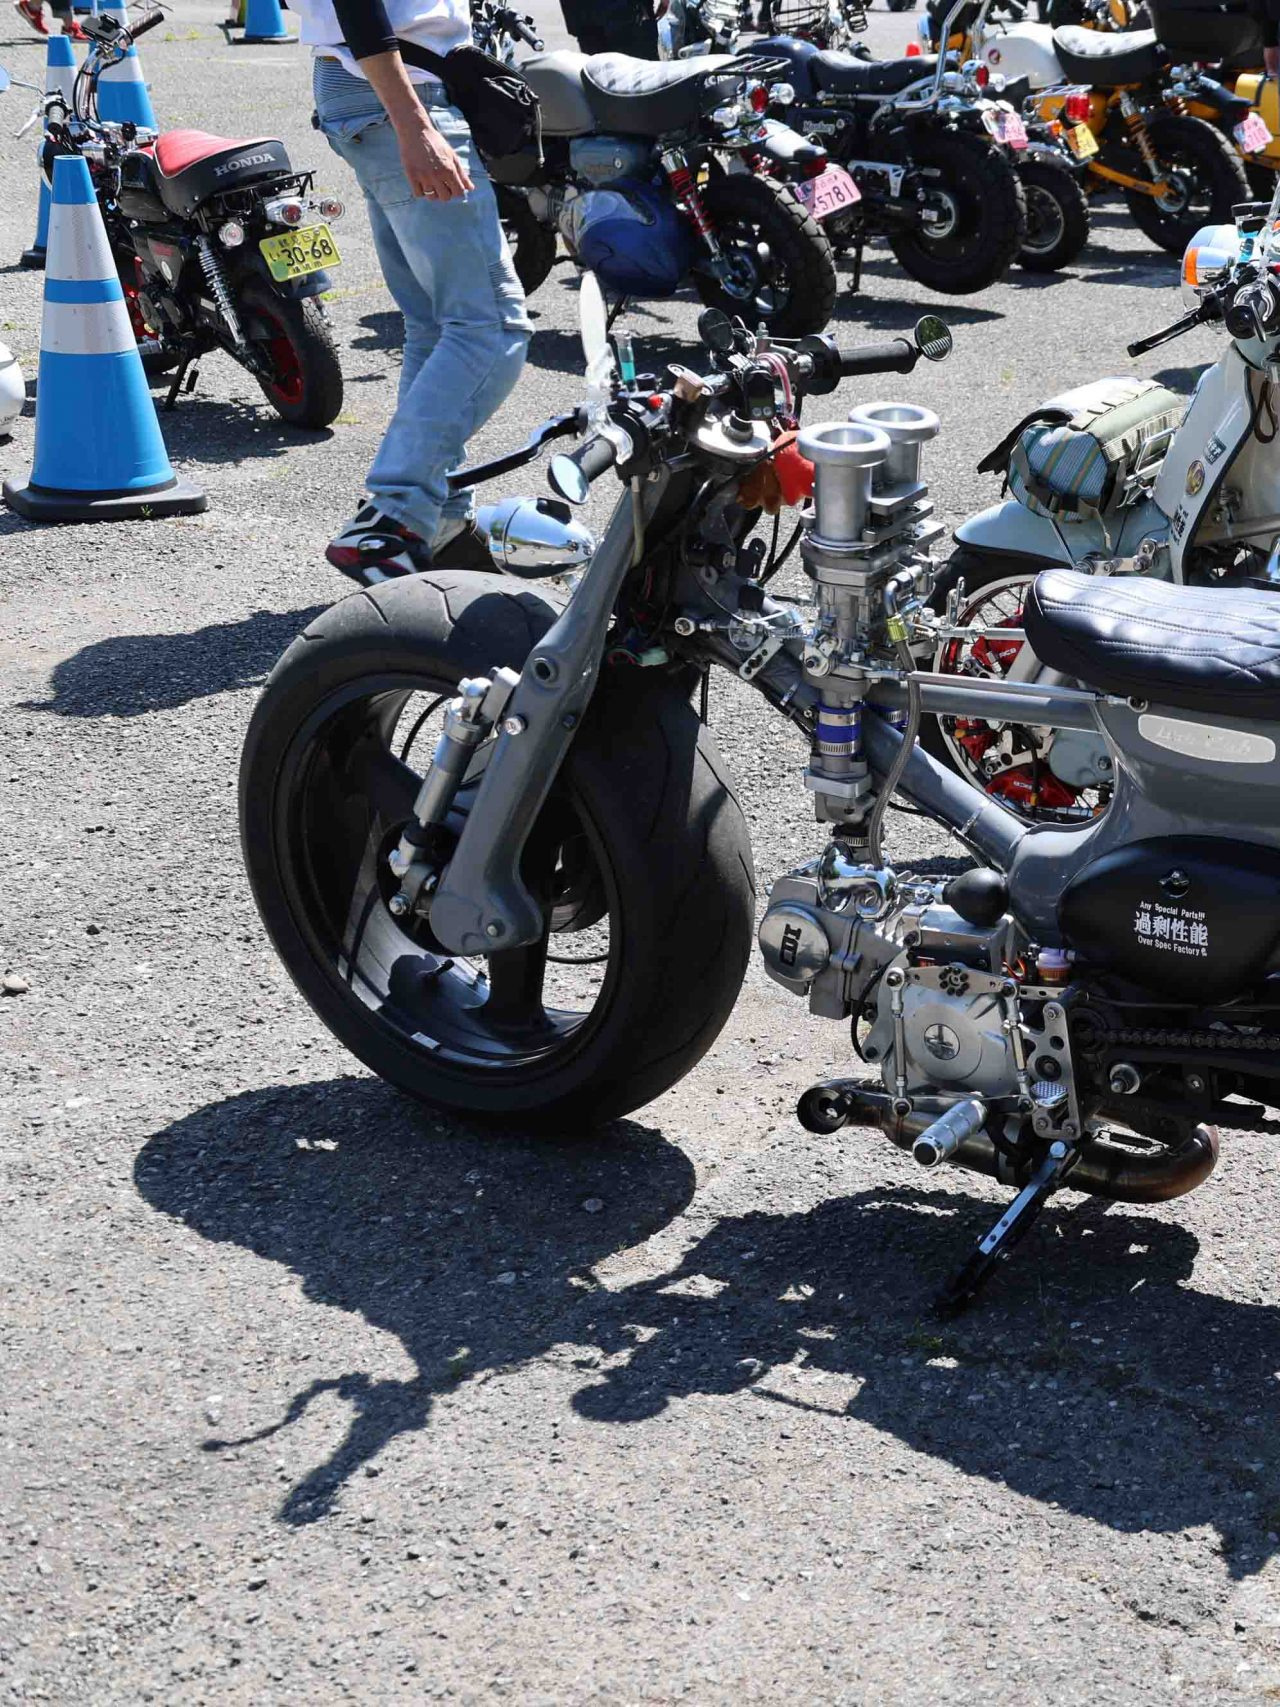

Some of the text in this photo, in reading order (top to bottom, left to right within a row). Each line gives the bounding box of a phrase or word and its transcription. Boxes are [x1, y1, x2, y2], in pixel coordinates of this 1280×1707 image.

[214, 153, 276, 177] HONDA
[817, 181, 854, 211] 5781
[281, 239, 333, 266] 30-68
[1139, 900, 1152, 911] Any
[1154, 903, 1179, 916] Special
[1133, 911, 1209, 947] 過剰性能
[1137, 935, 1200, 957] Over Spec Factory
